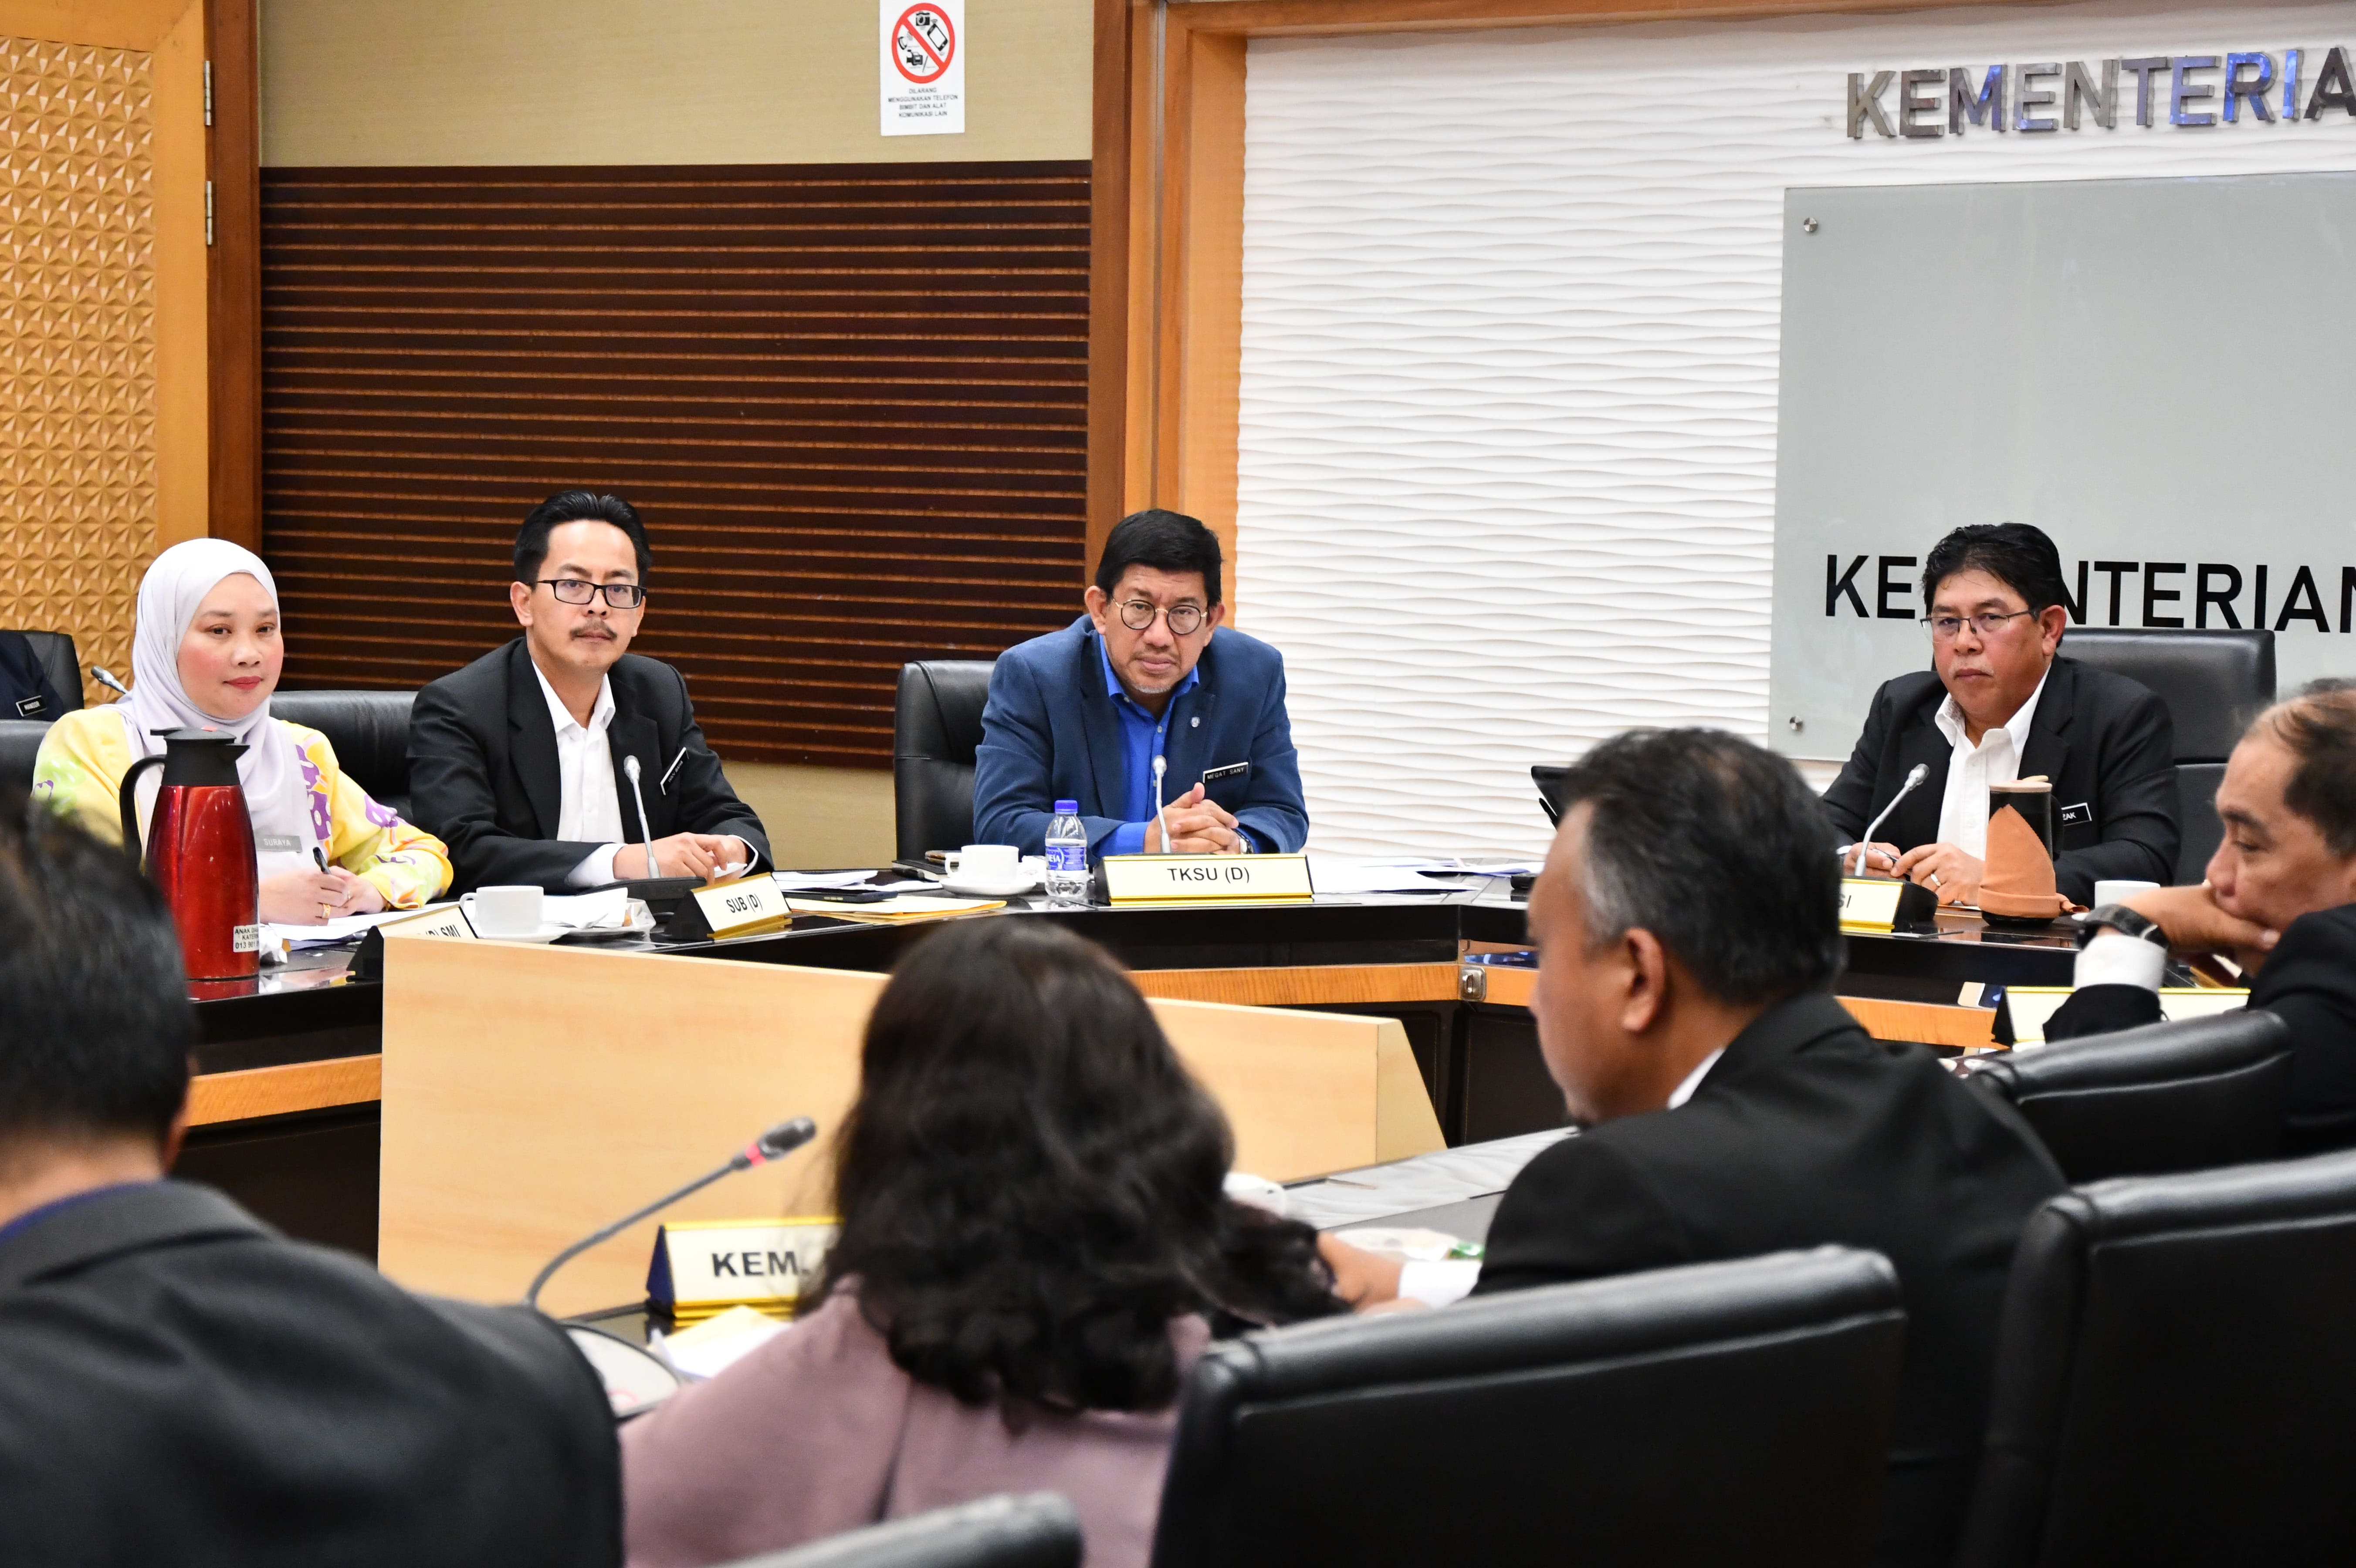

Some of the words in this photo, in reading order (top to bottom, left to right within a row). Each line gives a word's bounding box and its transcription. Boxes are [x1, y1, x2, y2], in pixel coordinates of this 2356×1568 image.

[1847, 47, 2356, 138] KEMENTERIA
[1826, 554, 2356, 633] KENTERIA
[1207, 770, 1226, 779] MEGAT
[1229, 767, 1244, 775] SANY
[1167, 868, 1218, 881] TKSU
[1225, 867, 1249, 884] (D)
[726, 897, 748, 913] SUB
[746, 893, 763, 912] (D)
